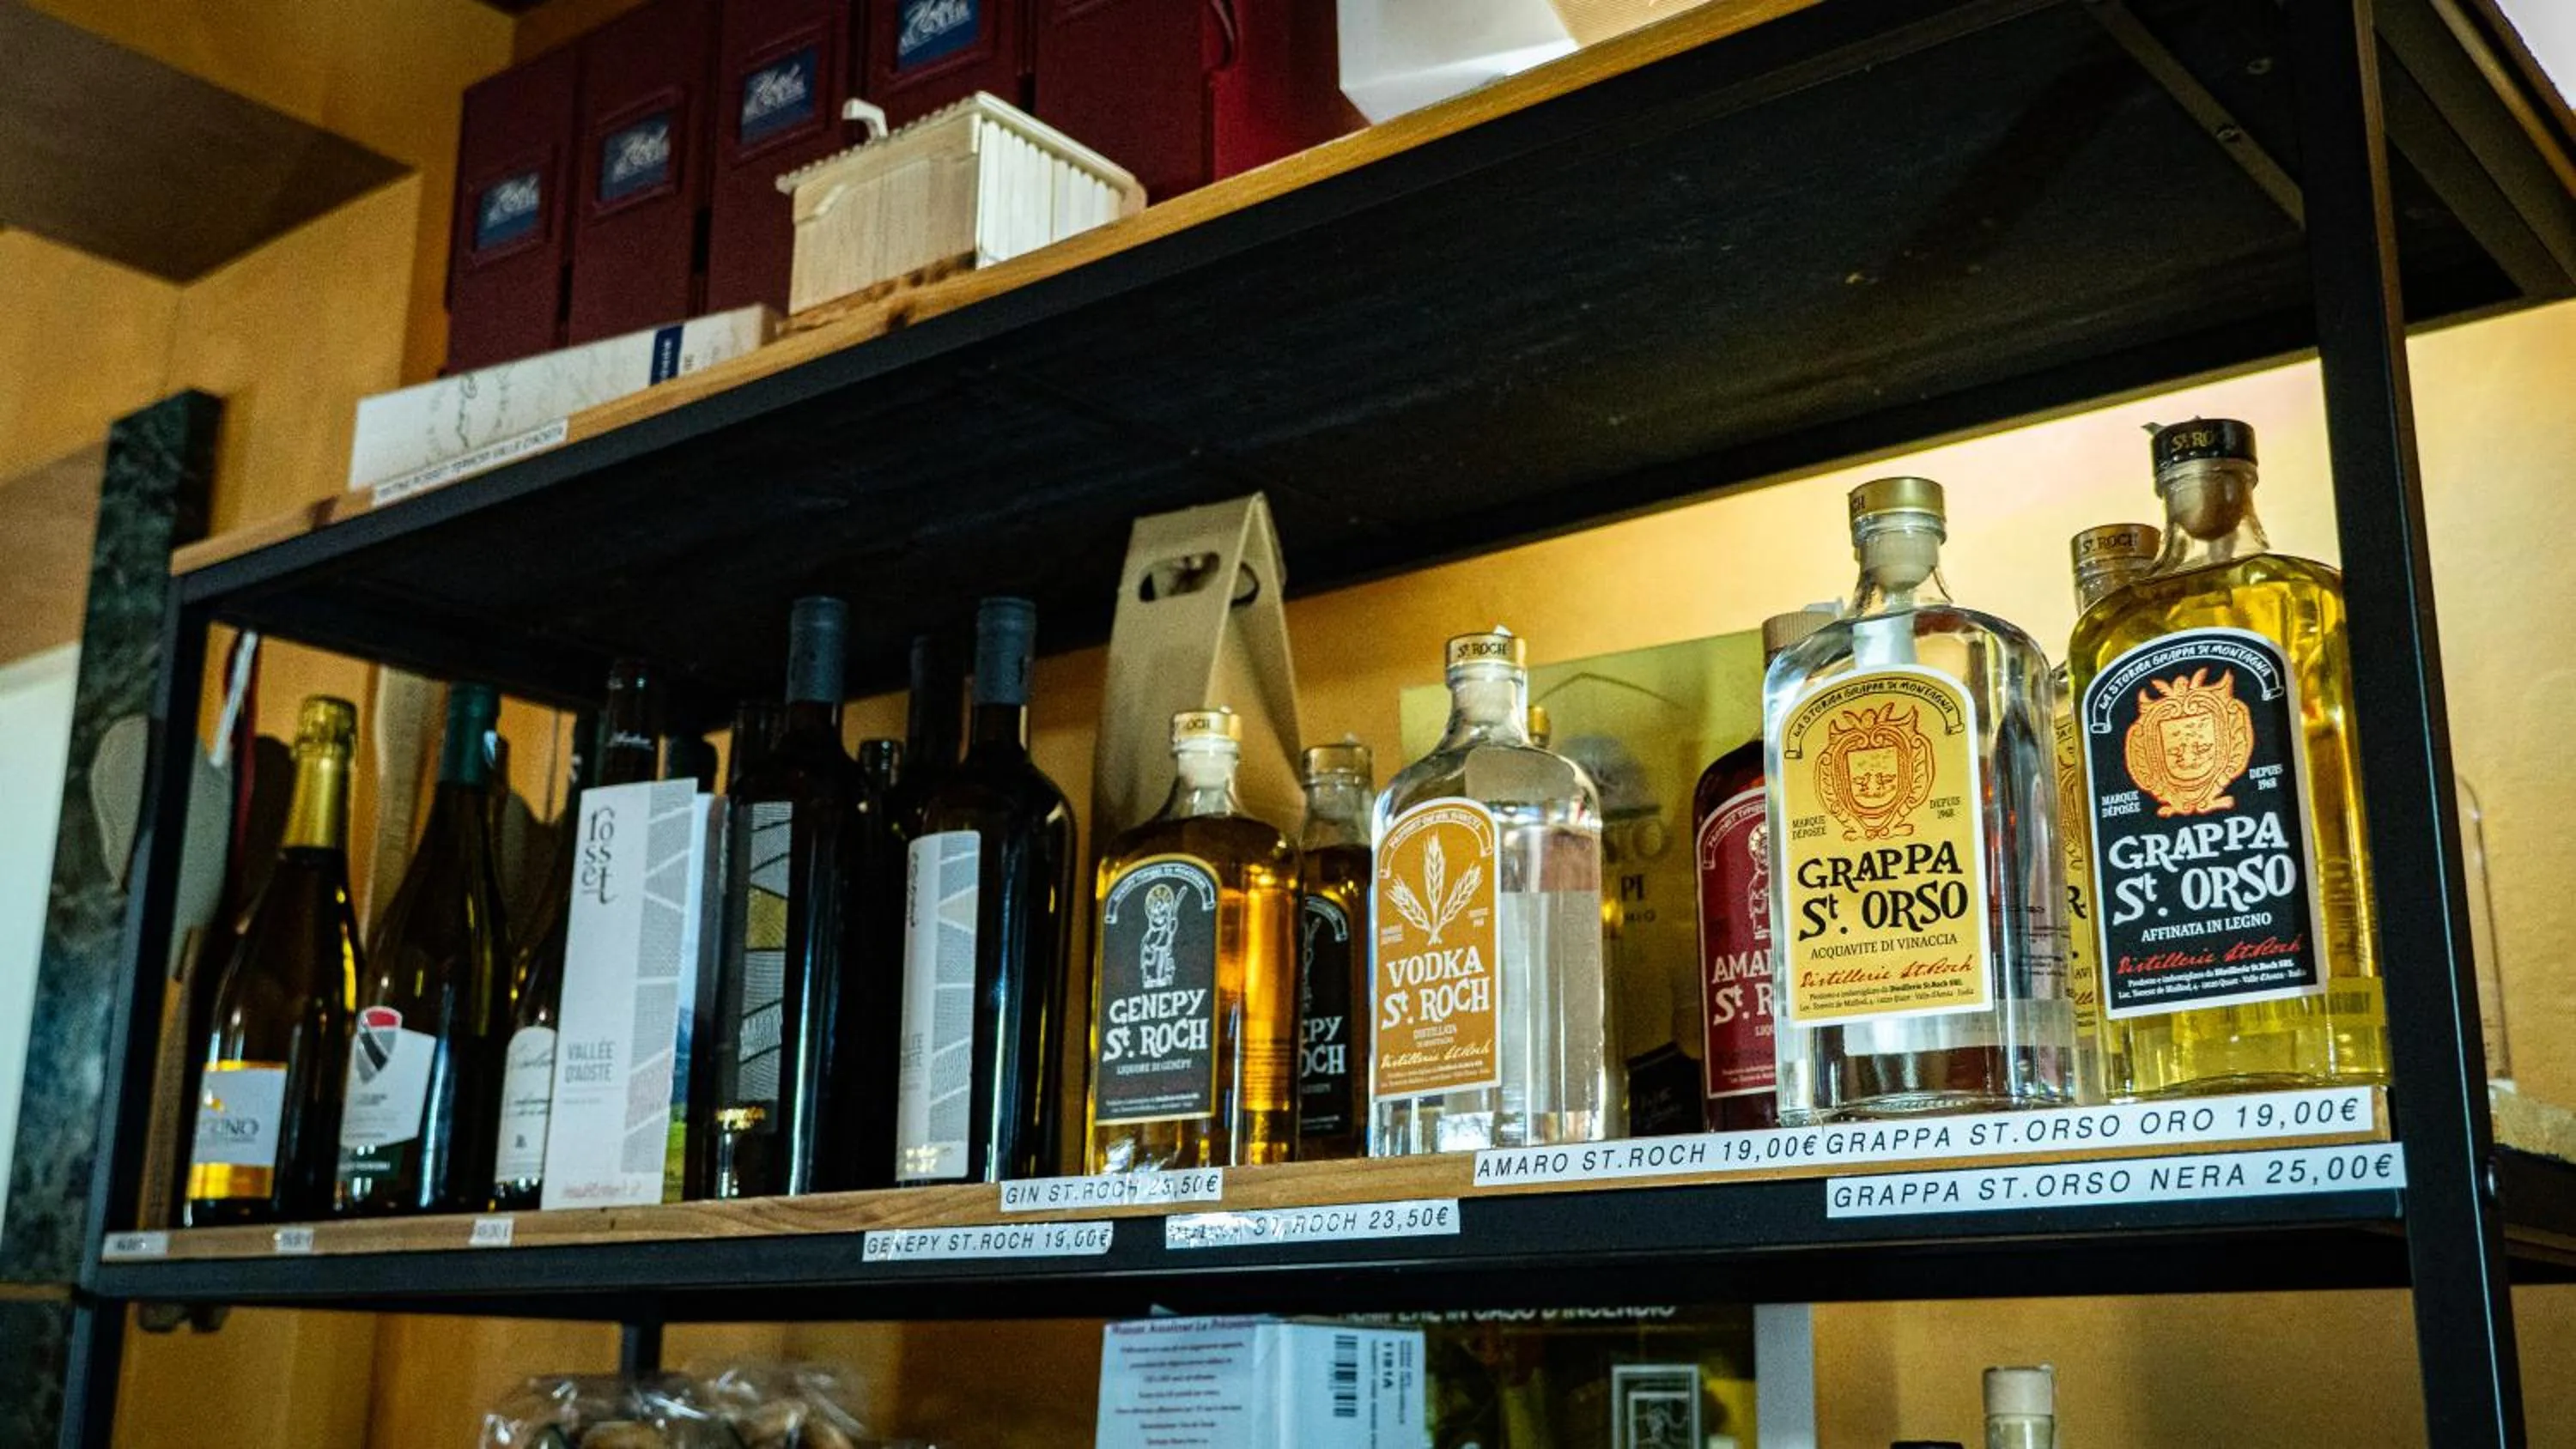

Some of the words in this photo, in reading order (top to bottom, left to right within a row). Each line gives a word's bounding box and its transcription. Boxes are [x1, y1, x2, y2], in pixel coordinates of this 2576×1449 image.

[2153, 647, 2195, 665] GRAPPA
[1929, 795, 1962, 809] DEPUIS
[2101, 790, 2140, 807] MARQUE
[1792, 815, 1826, 830] MARQUE
[2109, 811, 2290, 873] GRAPPA
[1797, 840, 1964, 894] GRAPPA
[2112, 872, 2169, 926] St.
[2181, 853, 2297, 913] ORSO
[1798, 893, 1849, 943] St.
[1862, 880, 1969, 933] ORSO
[2141, 922, 2205, 943] AFFINATA
[2207, 919, 2223, 934] IN
[2225, 912, 2273, 931] LEGNO
[1810, 942, 1878, 961] ACQUAVITE
[1881, 939, 1894, 953] DI
[1896, 933, 1959, 950] VINACCIA
[1386, 945, 1485, 988] VODKA
[1109, 988, 1207, 1024] GENEPY
[1381, 989, 1414, 1030] St.
[1419, 977, 1491, 1022] ROCH
[568, 1036, 617, 1061] VALLÉE
[1102, 1026, 1135, 1063] St.
[1139, 1017, 1210, 1058] ROCH
[565, 1063, 614, 1084] D'AOSTE
[1826, 1126, 1952, 1155] GRAPPA
[1970, 1115, 2121, 1146] ST.ORSO
[2140, 1108, 2215, 1136] ORO
[2237, 1098, 2359, 1130] 19,00€
[1477, 1153, 1569, 1178] AMARO
[1583, 1143, 1706, 1171] ST.ROCH
[1722, 1134, 1819, 1163] 19,00€
[1005, 1185, 1039, 1205] GIN
[1048, 1179, 1139, 1203] ST.ROCH
[1834, 1180, 1959, 1209] GRAPPA
[1978, 1170, 2130, 1202] ST.ORSO
[2150, 1163, 2245, 1191] NERA
[2266, 1153, 2394, 1186] 25,00€
[1369, 1205, 1449, 1232] 23,50€
[866, 1233, 942, 1255] GENEPY
[948, 1231, 1035, 1252] ST.ROCH
[1044, 1228, 1110, 1251] 19,00€
